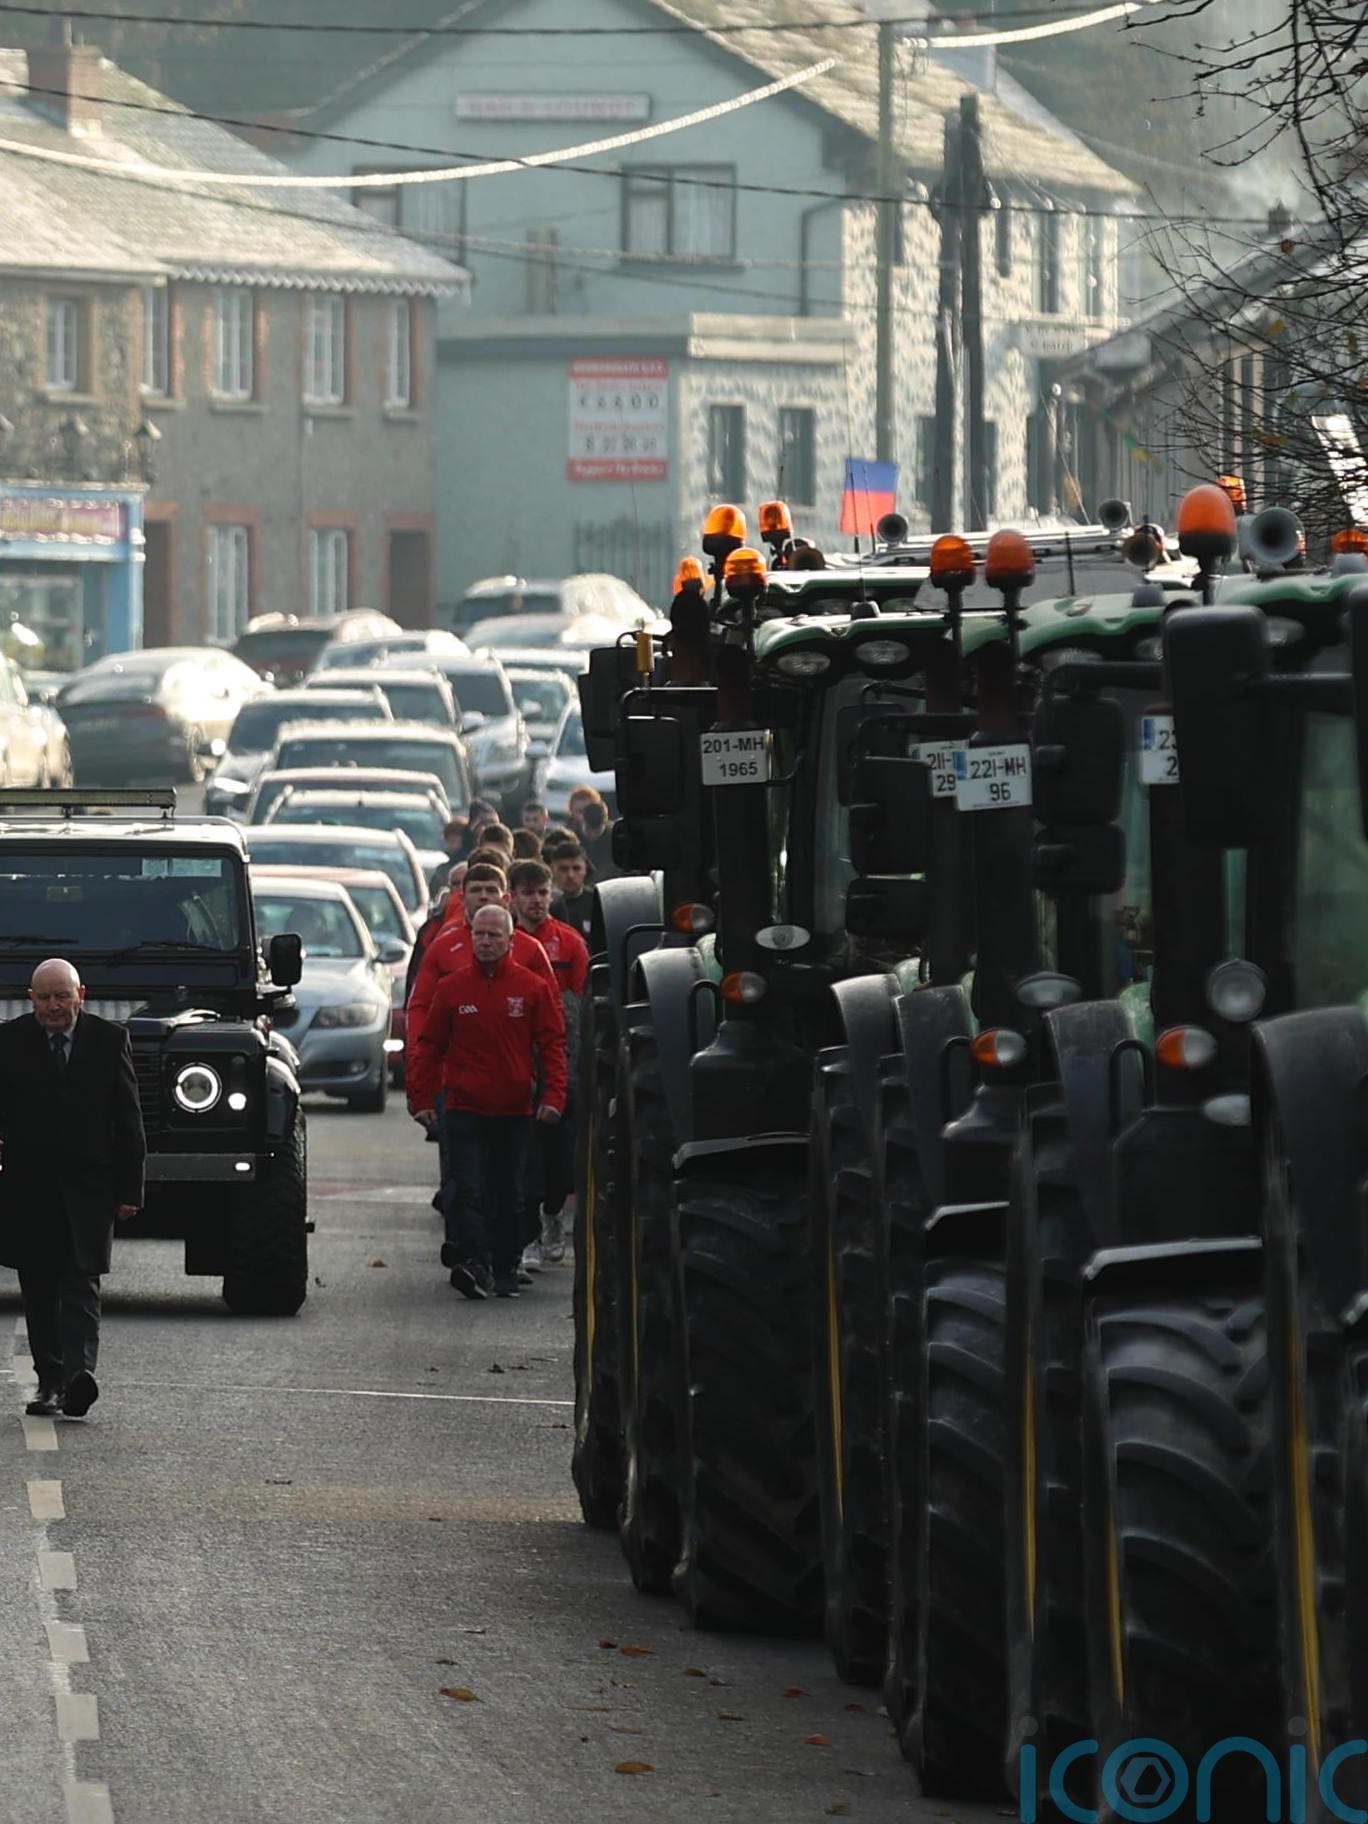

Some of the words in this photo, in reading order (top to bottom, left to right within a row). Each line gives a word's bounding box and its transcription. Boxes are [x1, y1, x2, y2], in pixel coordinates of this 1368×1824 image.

[703, 736, 764, 754] 201-MH
[719, 761, 758, 777] 1965
[927, 751, 958, 770] 211-
[970, 757, 1026, 779] 221-MH
[989, 783, 1012, 801] 96
